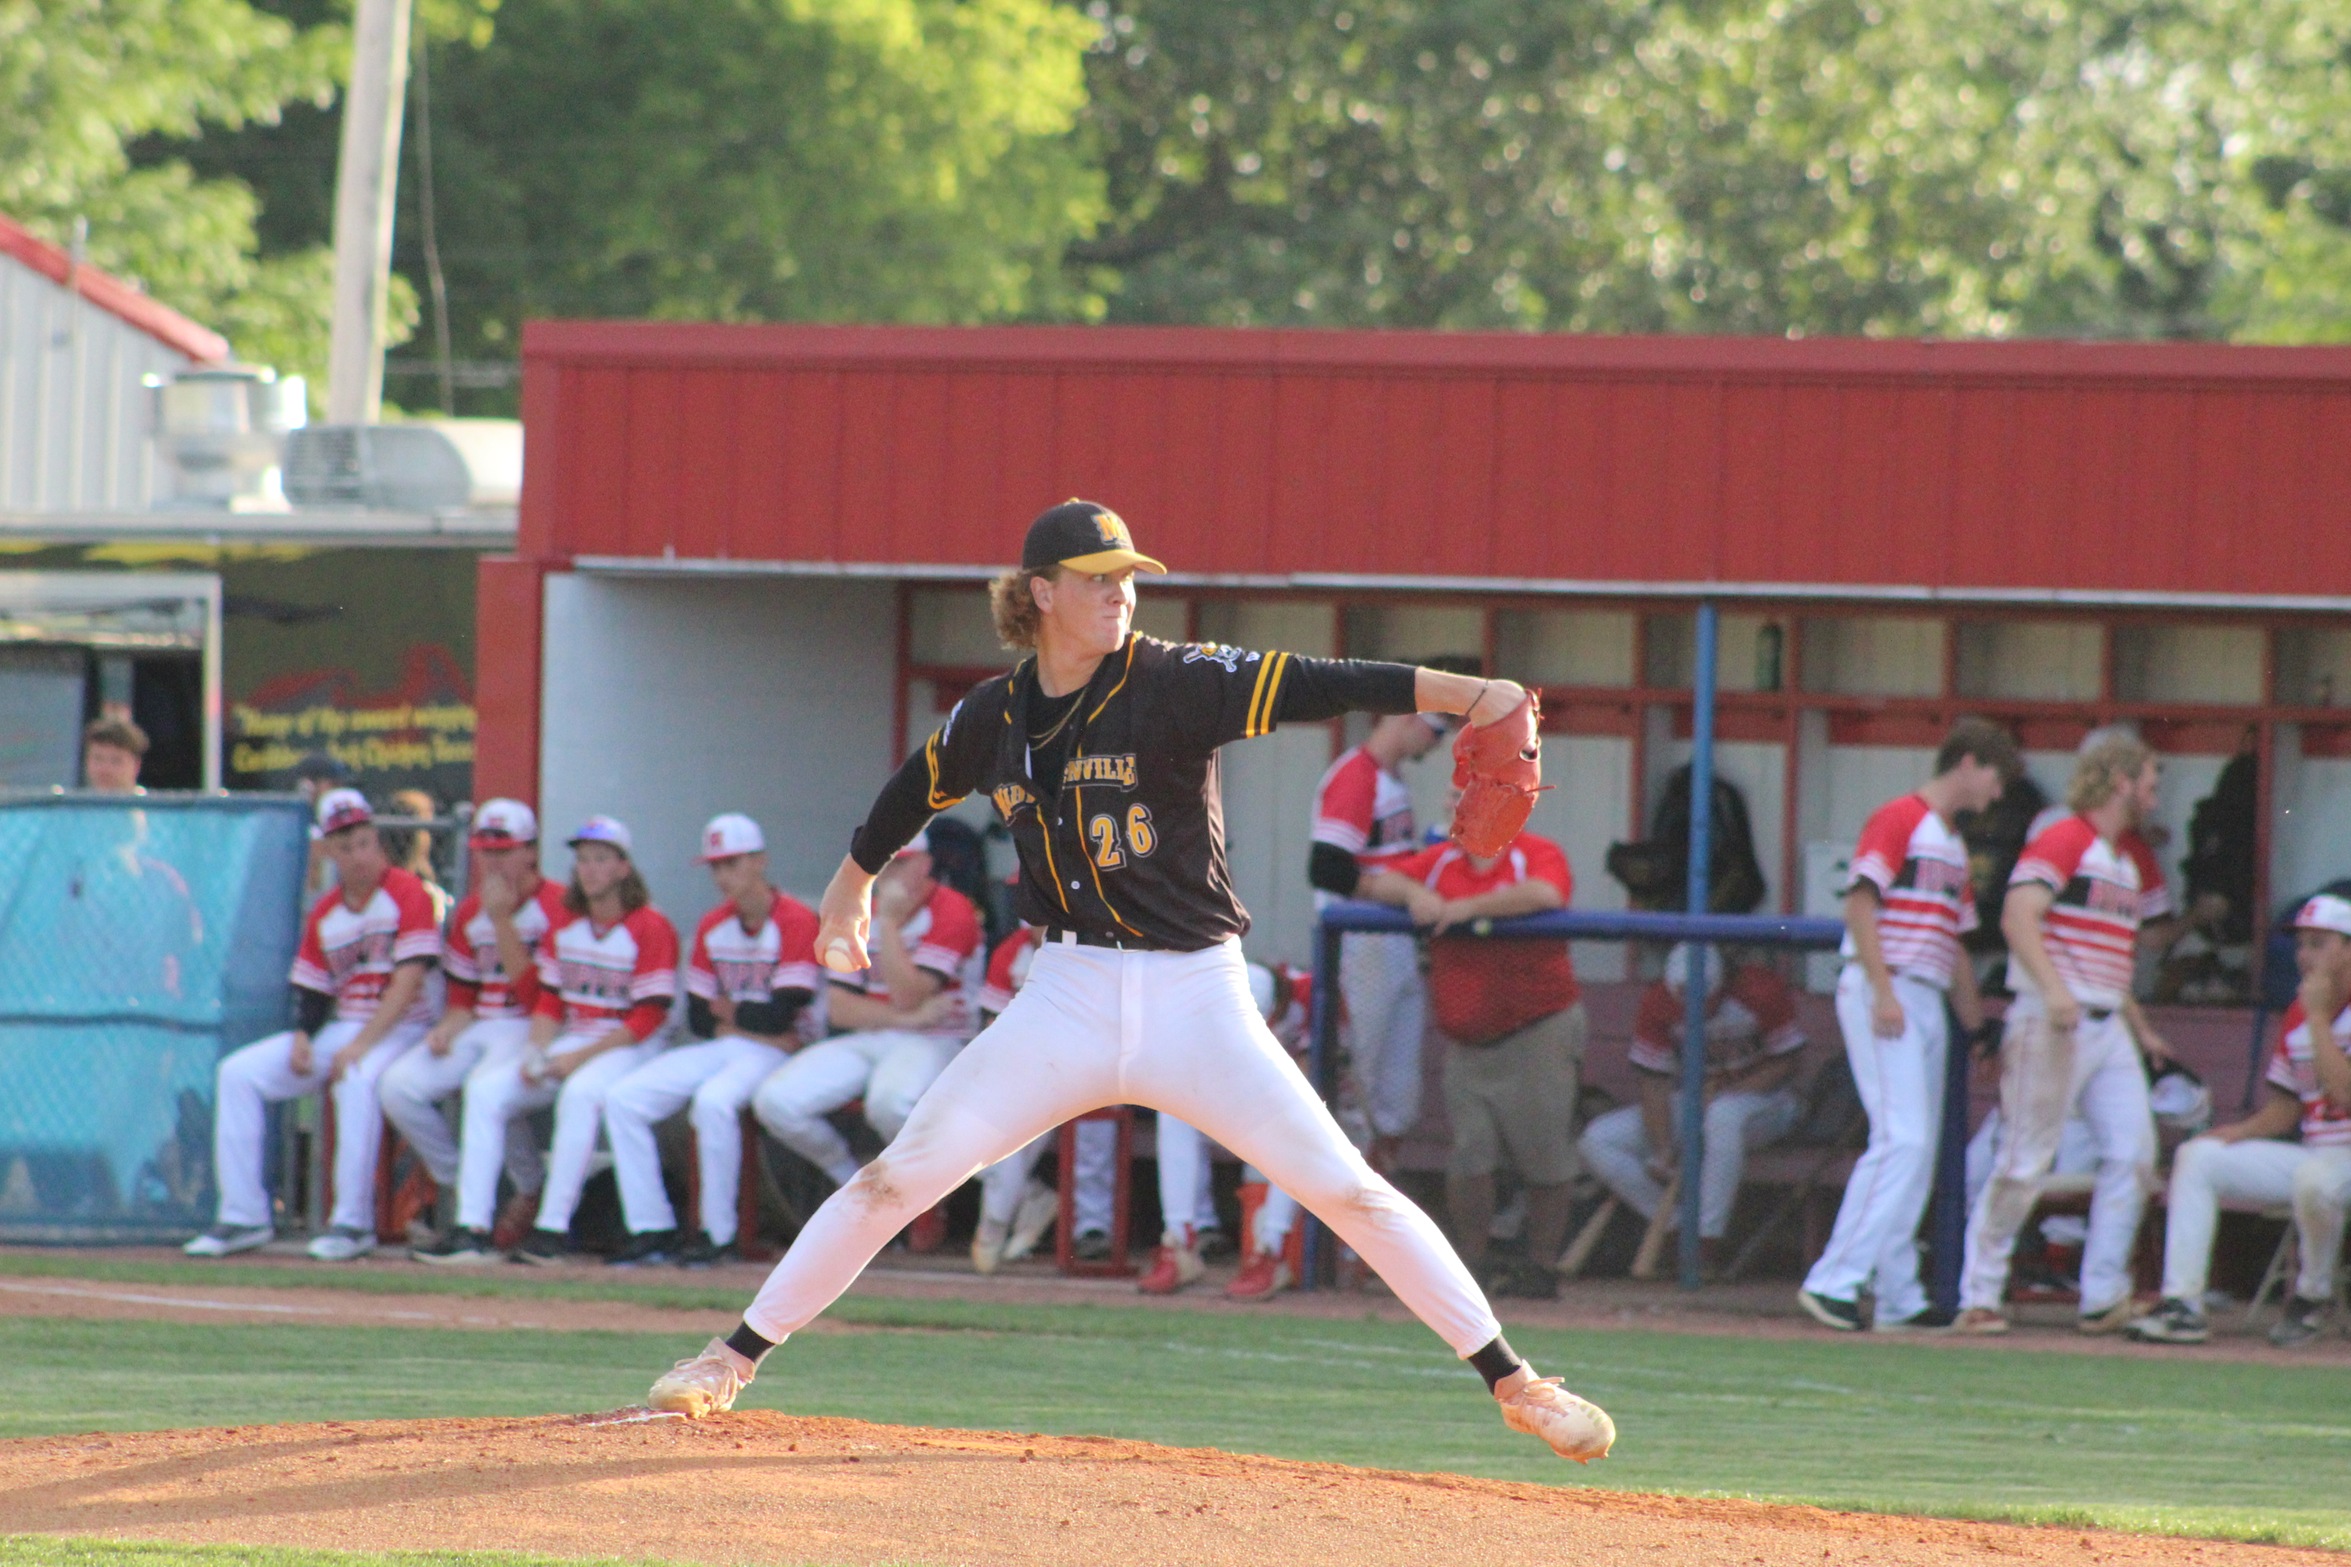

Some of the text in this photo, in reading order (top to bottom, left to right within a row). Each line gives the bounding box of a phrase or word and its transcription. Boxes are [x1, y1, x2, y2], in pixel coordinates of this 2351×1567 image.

[1092, 514, 1127, 545] M
[1063, 755, 1136, 787] NVILLE
[1090, 804, 1157, 871] 26
